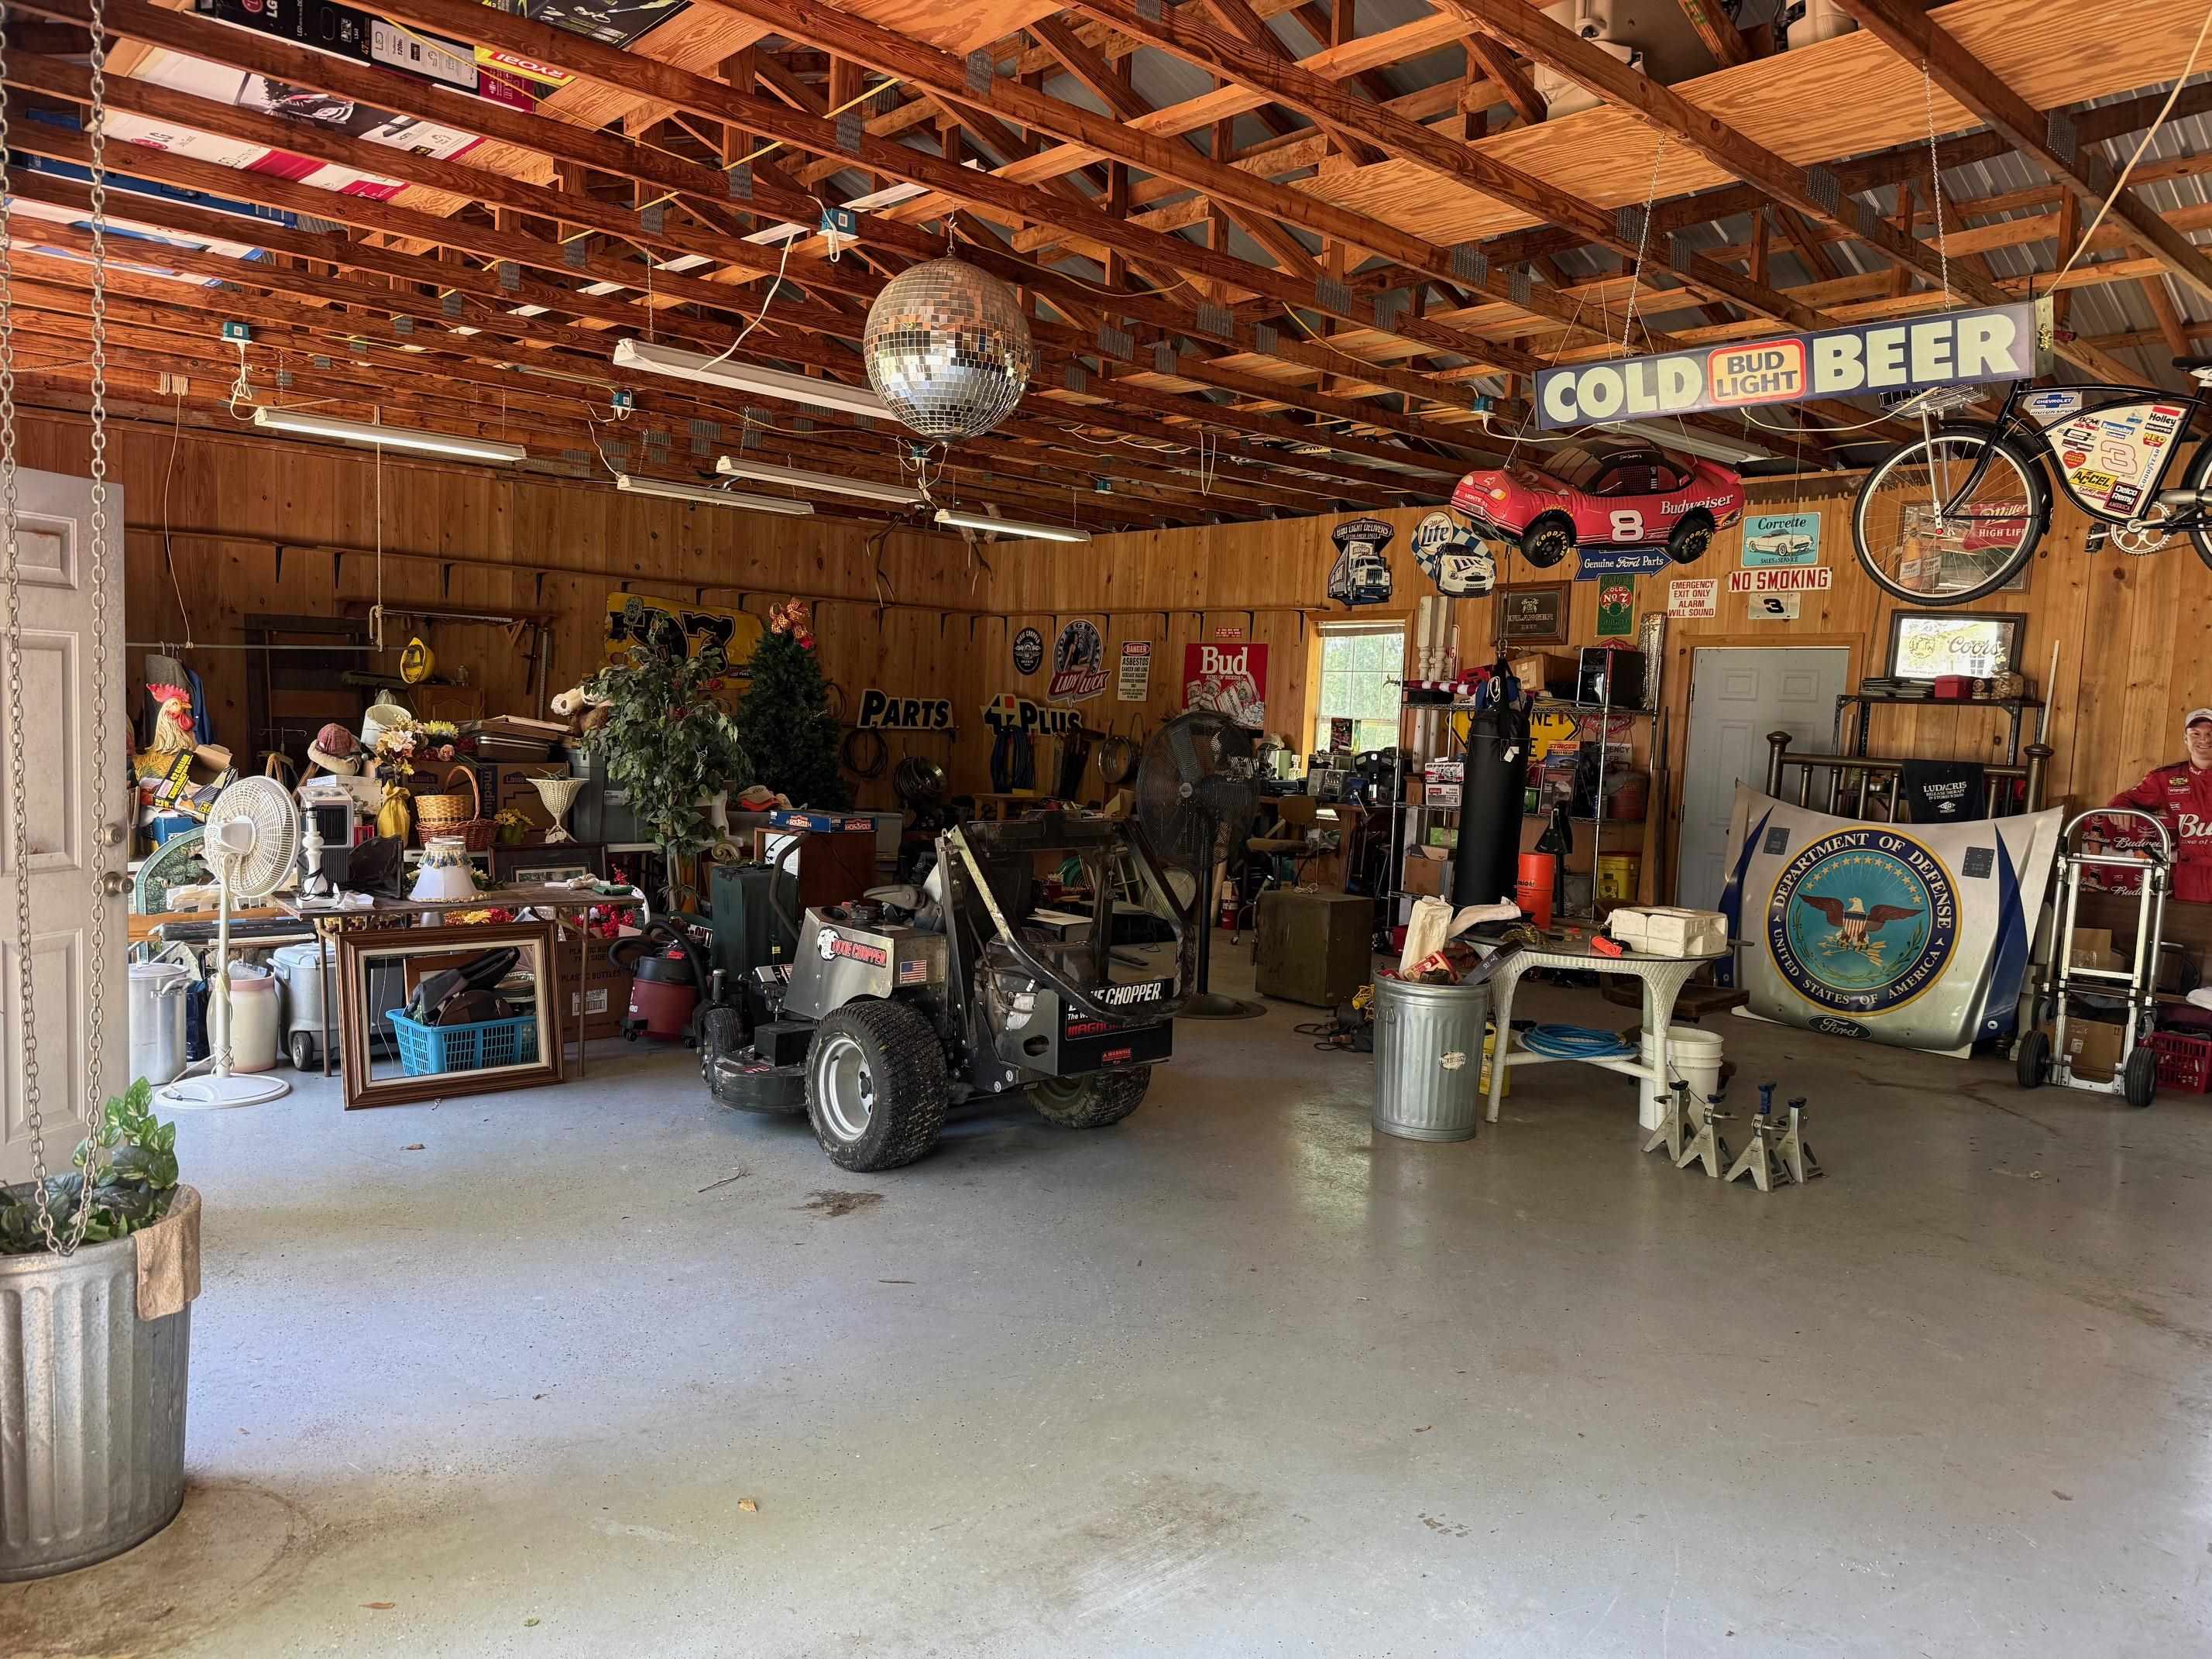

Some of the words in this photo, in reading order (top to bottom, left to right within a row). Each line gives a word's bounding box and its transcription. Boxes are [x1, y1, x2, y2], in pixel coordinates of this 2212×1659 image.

[266, 0, 278, 18] LG
[495, 53, 565, 77] RYOBI
[1726, 351, 1784, 375] BUD
[1812, 314, 2020, 393] BEER
[1543, 356, 1702, 423] COLD
[1717, 369, 1798, 398] LIGHT
[2148, 412, 2177, 427] Holley
[2144, 432, 2166, 443] NEO
[2100, 440, 2138, 476] 3
[2140, 448, 2161, 489] GOODYEAR
[2073, 471, 2110, 488] ACCEL
[2111, 493, 2135, 504] Remy
[2115, 486, 2138, 496] Delco
[1661, 494, 1734, 515] Budweiser
[1980, 503, 2027, 524] Miller
[1348, 524, 1363, 533] LIGHT
[1609, 510, 1645, 541] 8
[1758, 517, 1807, 531] Corvette
[1979, 528, 2004, 538] HIGH
[2006, 528, 2025, 537] LIF
[1420, 525, 1449, 547] Lite
[1536, 531, 1568, 557] GOODYEAR
[1454, 558, 1484, 572] Lite
[1584, 558, 1615, 568] Genuine
[1616, 555, 1641, 568] Ford
[1642, 555, 1664, 567] Parts
[1779, 555, 1799, 564] SERVICE
[1671, 580, 1715, 589] EMERGENCY
[1732, 571, 1752, 591] NO
[1757, 568, 1829, 590] SMOKING
[1620, 592, 1629, 603] 7
[1678, 599, 1705, 608] ALARM
[1763, 597, 1784, 613] 3
[1668, 609, 1687, 617] WILL
[1688, 607, 1715, 617] SOUND
[1948, 636, 2002, 655] Coors
[1122, 657, 1149, 666] ASBESTOS
[1200, 646, 1249, 675] Bud
[1054, 675, 1080, 693] LADY
[1079, 673, 1107, 692] LUCK
[860, 690, 950, 728] PARTS
[1019, 701, 1082, 736] PLUS
[1922, 781, 1967, 793] LUDACRIS
[1772, 832, 1870, 909] DEPARTMENT
[1878, 836, 1905, 855] OF
[1908, 850, 1953, 929] DEFENSE
[831, 938, 852, 957] DIXIE
[851, 943, 886, 966] CHOPPER
[1774, 929, 1801, 978] UNITED
[1802, 977, 1851, 1005] STATES
[1860, 993, 1879, 1006] OF
[1887, 950, 1941, 1001] AMERICA
[1819, 1018, 1861, 1039] Ford
